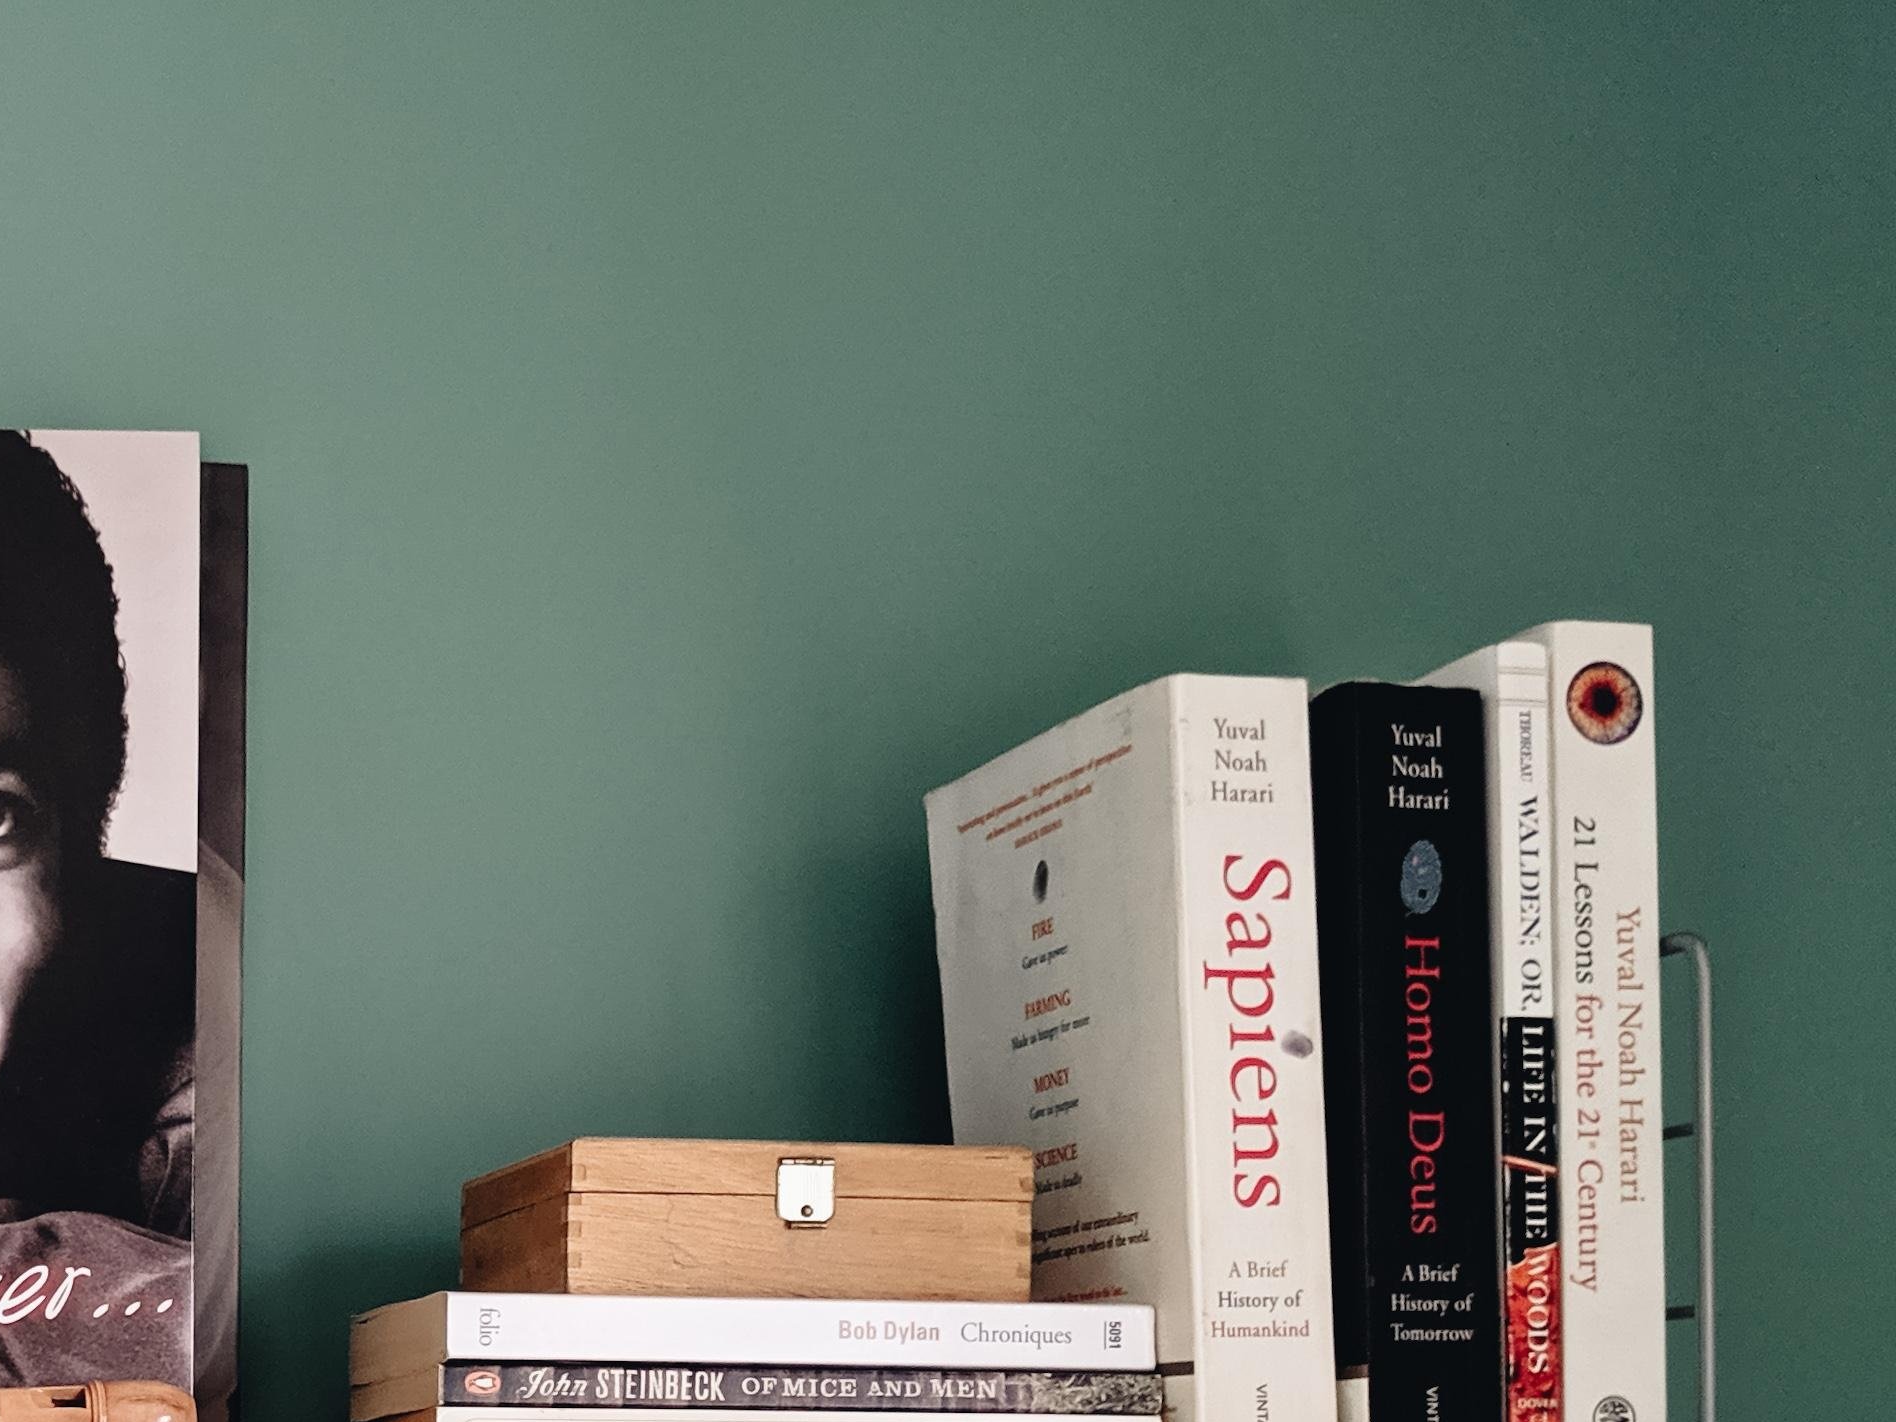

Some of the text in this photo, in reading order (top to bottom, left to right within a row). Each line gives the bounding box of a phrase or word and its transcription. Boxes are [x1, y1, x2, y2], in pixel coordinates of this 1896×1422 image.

[1213, 719, 1266, 740] Yuval
[1392, 724, 1442, 747] Yuval
[1215, 751, 1267, 772] Noah
[1519, 710, 1533, 783] THOREAU
[1392, 755, 1443, 779] Noah
[1211, 781, 1274, 803] Harari
[1389, 786, 1449, 810] Harari
[1574, 816, 1596, 849] 21
[1574, 862, 1598, 984] Lessons
[1203, 855, 1292, 1208] Sapiens
[1576, 992, 1603, 1039] for
[1522, 1026, 1545, 1103] LIFE
[1617, 905, 1647, 1203] Yuval Noah Harari
[1405, 936, 1445, 1234] Homo Deus
[1576, 1049, 1604, 1097] the
[1524, 1117, 1546, 1155] IN
[1525, 1169, 1547, 1239] THE
[1570, 1158, 1604, 1292] Century
[1229, 1261, 1288, 1278] A Brief
[1402, 1264, 1460, 1282] A Brief
[1218, 1288, 1303, 1312] History of
[1391, 1292, 1474, 1316] History of
[1527, 1253, 1550, 1375] WOODS
[479, 1307, 501, 1346] folio
[839, 1320, 1072, 1349] Bob Dylan Chroniques
[1109, 1321, 1122, 1350] 5091
[1211, 1320, 1310, 1339] Humankind
[1391, 1323, 1474, 1342] Tomorrow
[517, 1368, 997, 1400] John STEINBECK OF MICE AND MEN
